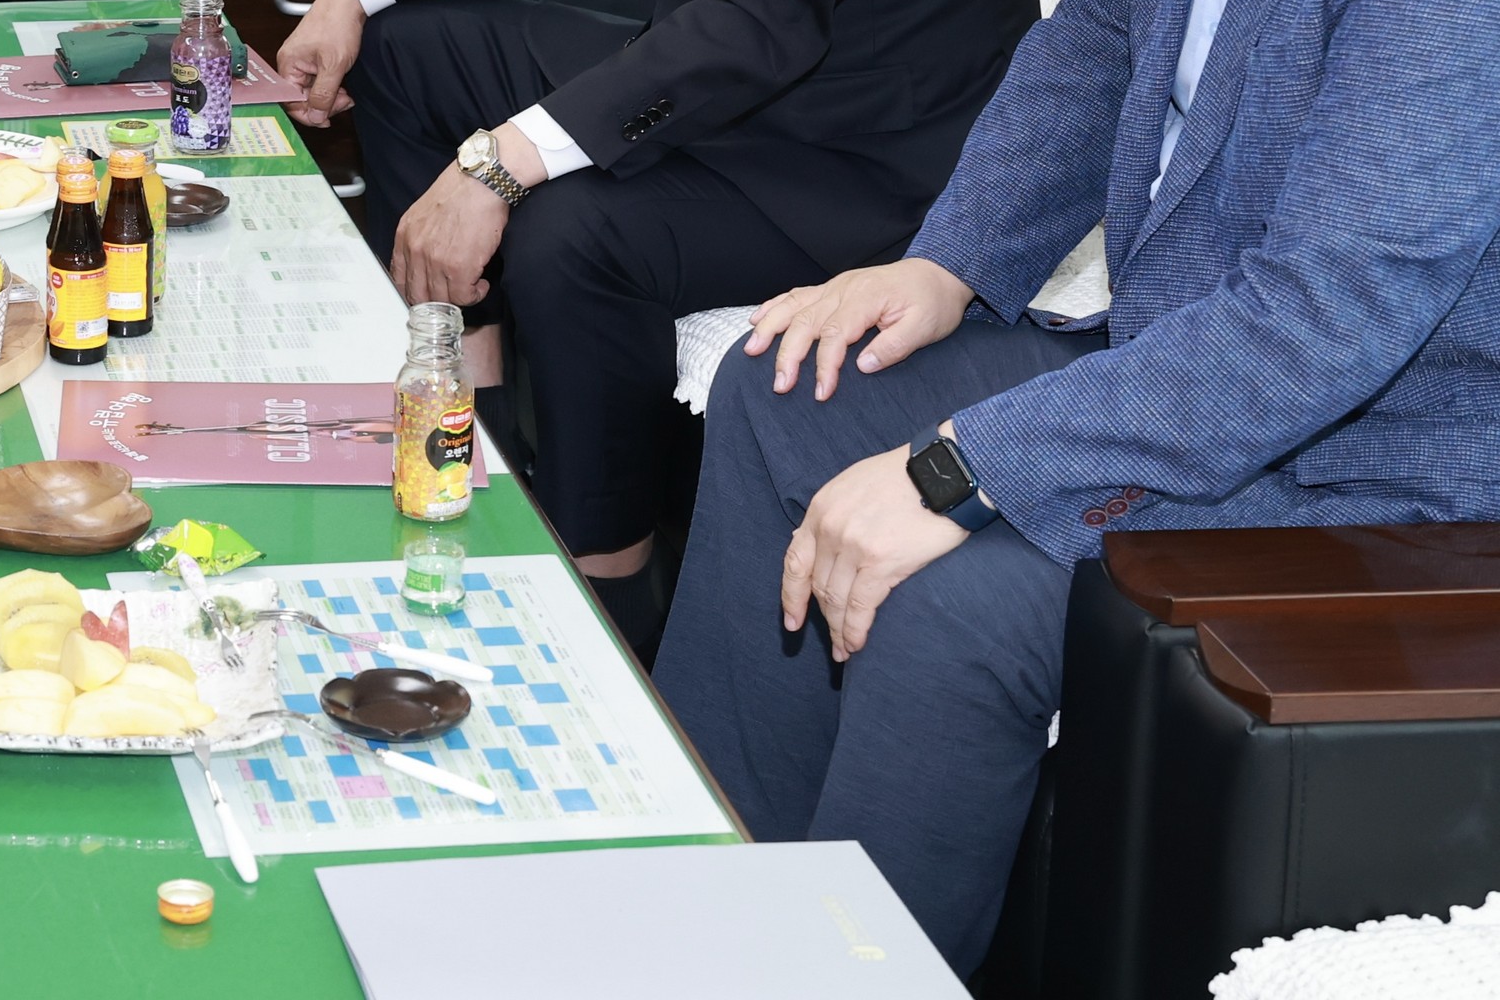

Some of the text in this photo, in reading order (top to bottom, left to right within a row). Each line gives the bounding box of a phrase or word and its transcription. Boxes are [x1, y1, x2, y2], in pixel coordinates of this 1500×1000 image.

[89, 392, 153, 429] 유럽여행
[267, 398, 309, 463] CLASSIC
[443, 445, 470, 459] 오렌지
